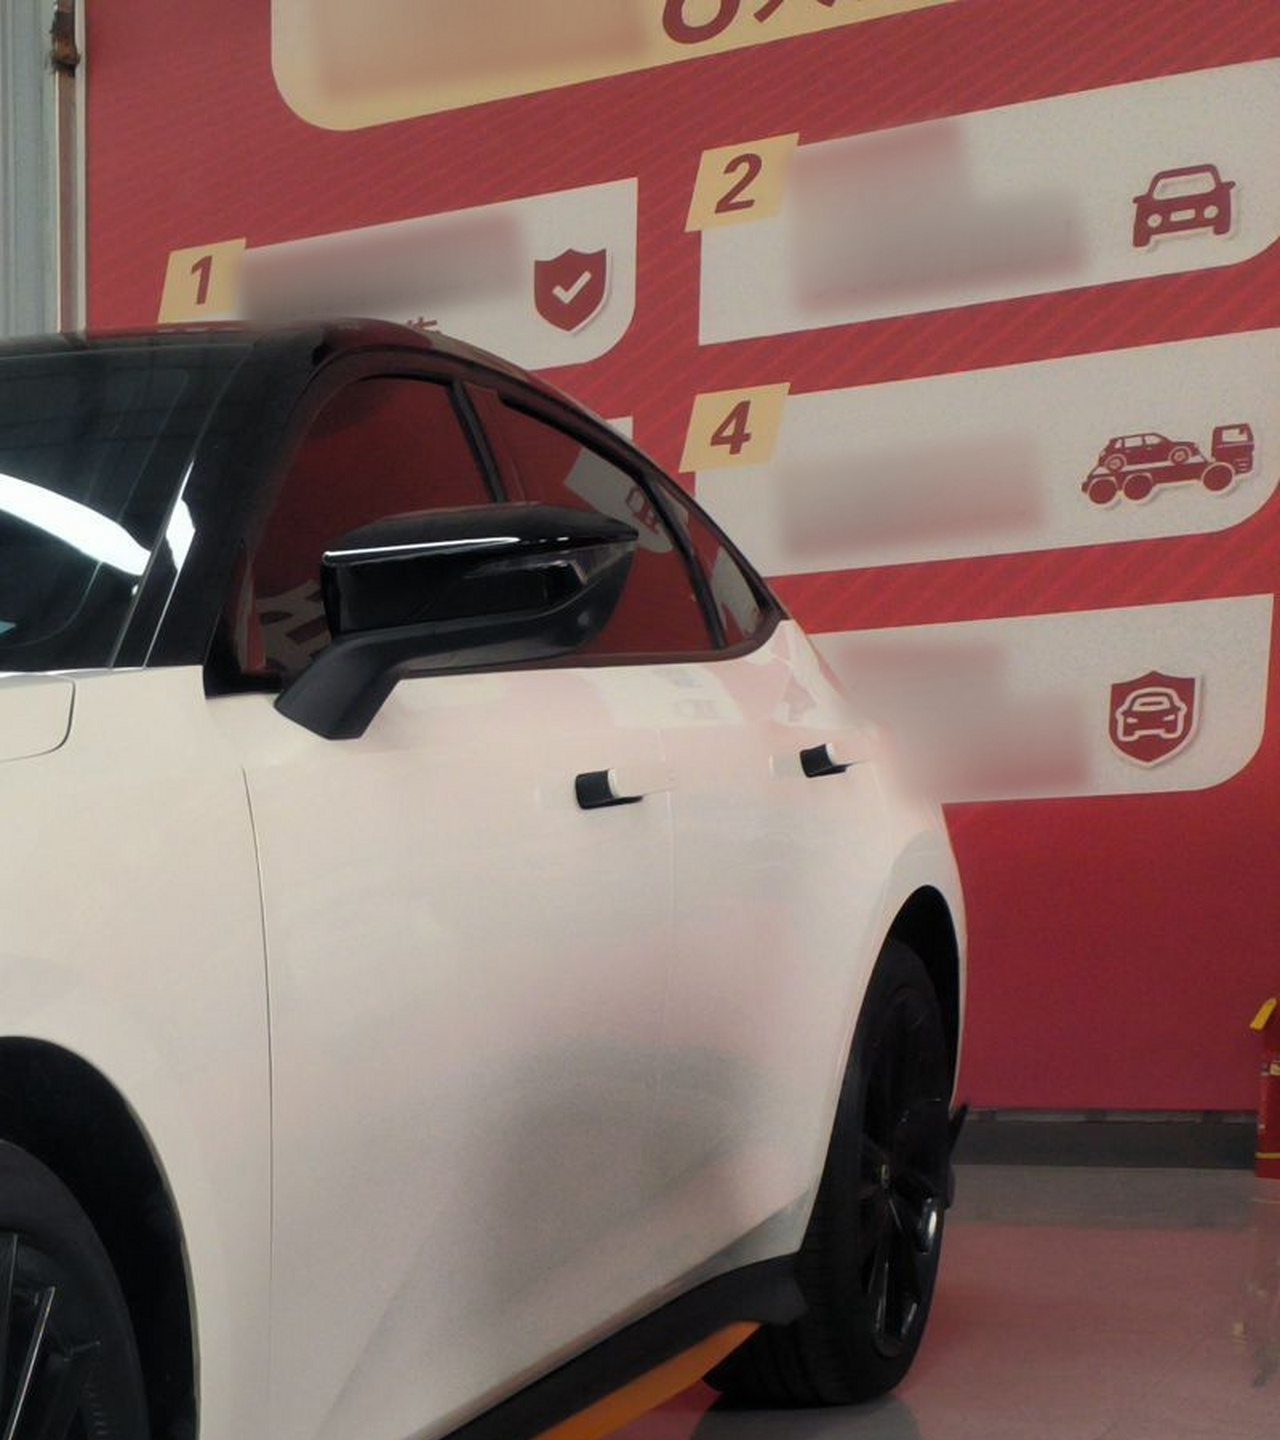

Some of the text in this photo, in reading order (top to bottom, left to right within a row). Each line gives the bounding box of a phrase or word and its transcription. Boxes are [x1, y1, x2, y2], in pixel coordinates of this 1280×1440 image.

[714, 153, 762, 214] 2
[191, 255, 213, 305] 1
[710, 400, 751, 456] 4
